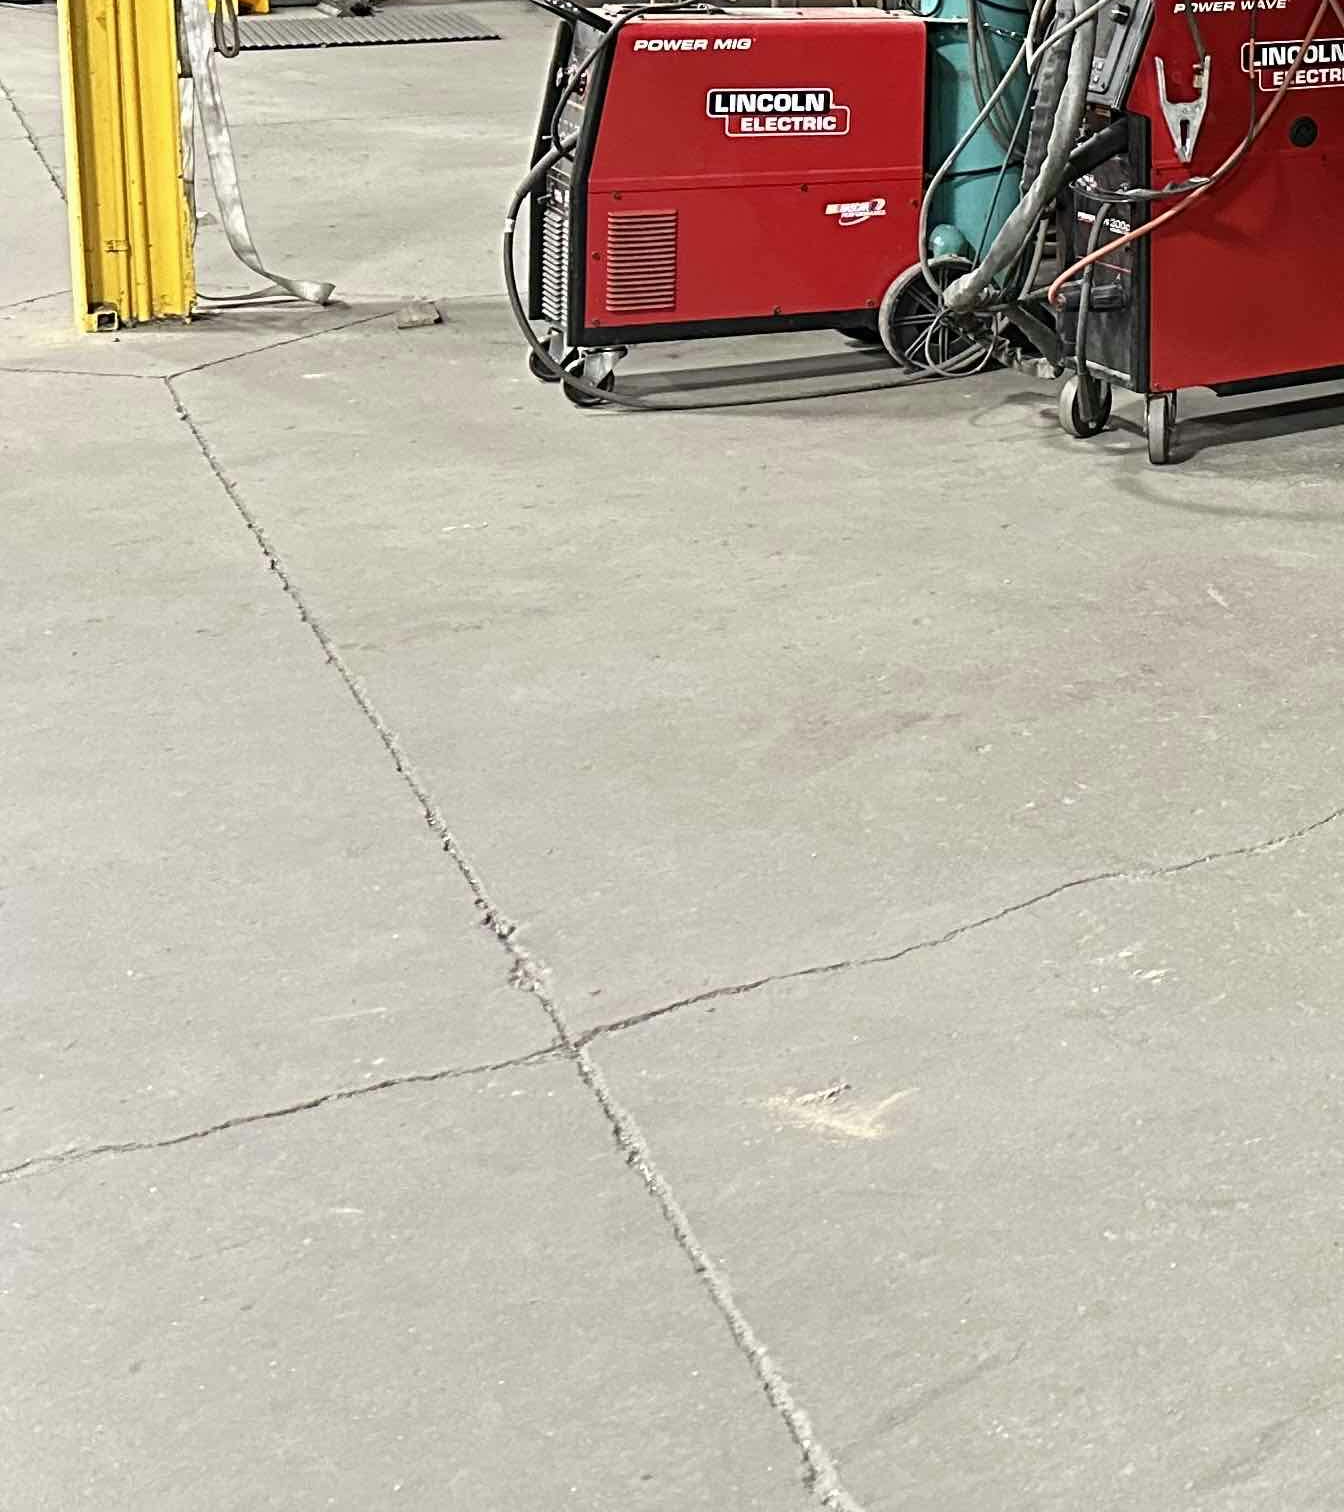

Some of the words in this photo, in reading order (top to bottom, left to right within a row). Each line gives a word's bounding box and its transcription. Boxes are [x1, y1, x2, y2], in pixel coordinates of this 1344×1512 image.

[633, 39, 708, 52] POWER
[713, 38, 752, 50] MIG
[715, 93, 825, 113] LINCOLN
[740, 116, 837, 132] ELECTRIC
